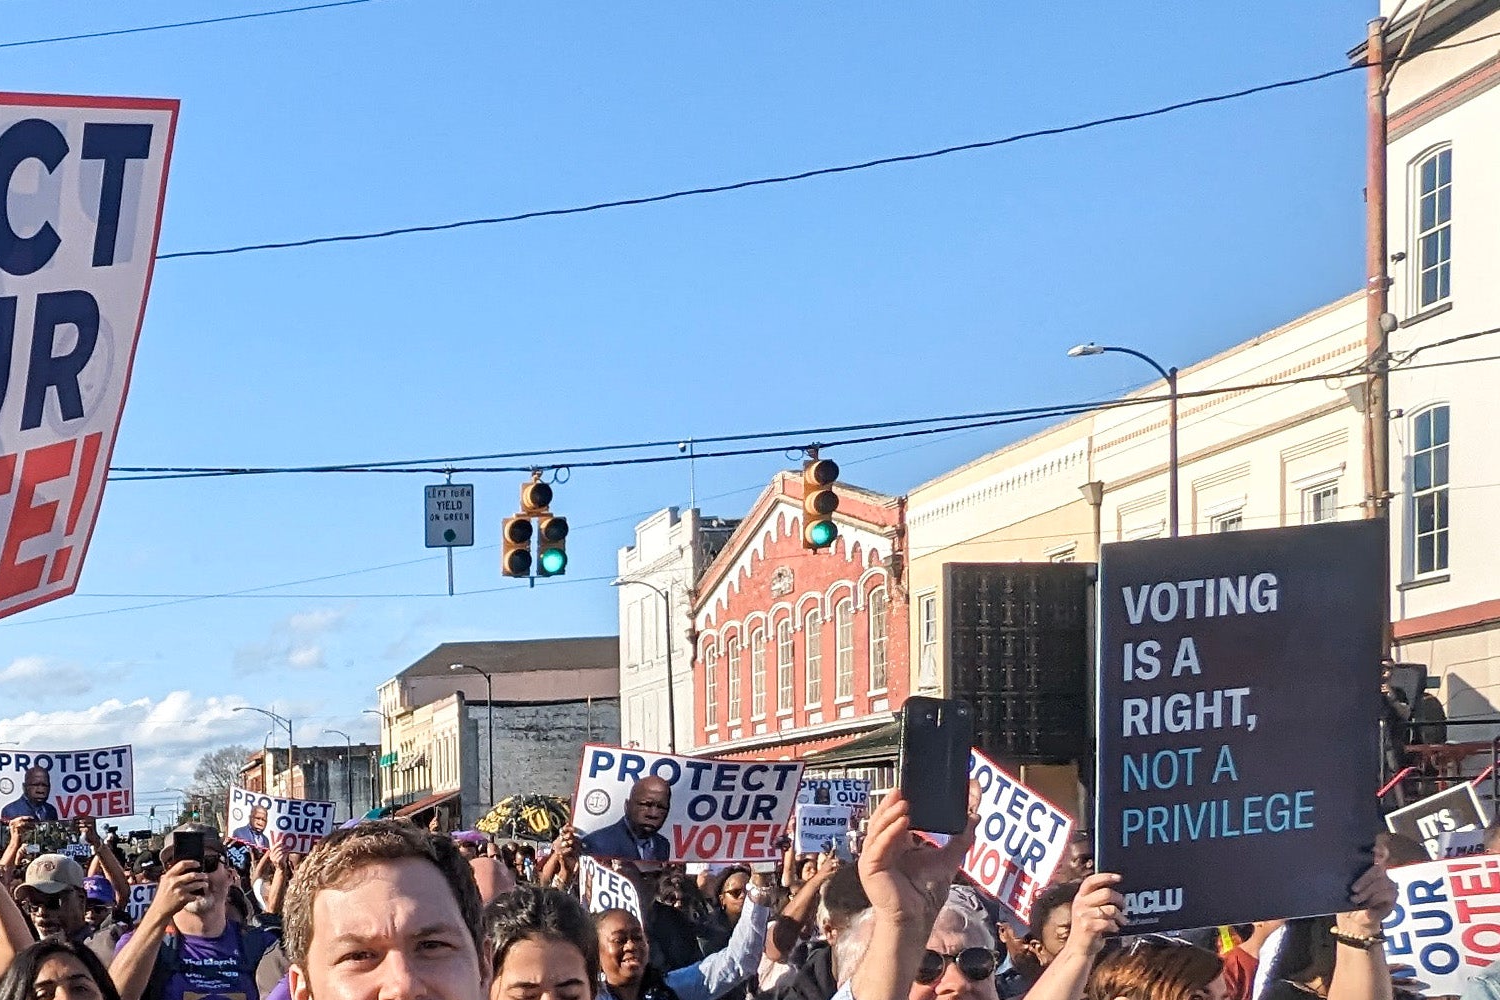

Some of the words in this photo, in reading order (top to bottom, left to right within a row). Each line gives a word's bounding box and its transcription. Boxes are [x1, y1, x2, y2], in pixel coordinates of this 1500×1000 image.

[430, 513, 440, 521] ON
[437, 501, 462, 510] YIELD
[1122, 572, 1279, 625] VOTING
[1123, 639, 1162, 682] IS
[1173, 637, 1202, 677] A
[1123, 687, 1258, 737] RIGHT,
[62, 771, 122, 793] OUR
[588, 750, 798, 792] PROTECT
[1123, 745, 1203, 792] NOT
[1211, 744, 1239, 784] A
[799, 780, 870, 792] PROTECT
[837, 792, 867, 802] OUR
[55, 790, 130, 818] VOTE!
[233, 789, 332, 818] PROTECT
[687, 794, 778, 822] OUR
[1122, 790, 1316, 847] PRIVILEGE
[276, 815, 325, 834] OUR
[1417, 809, 1455, 839] IT'S
[672, 823, 783, 859] VOTE!
[985, 812, 1047, 874] OUR
[968, 842, 1040, 917] VOTE!
[1123, 887, 1183, 915] ACLU
[1407, 877, 1460, 975] OUR
